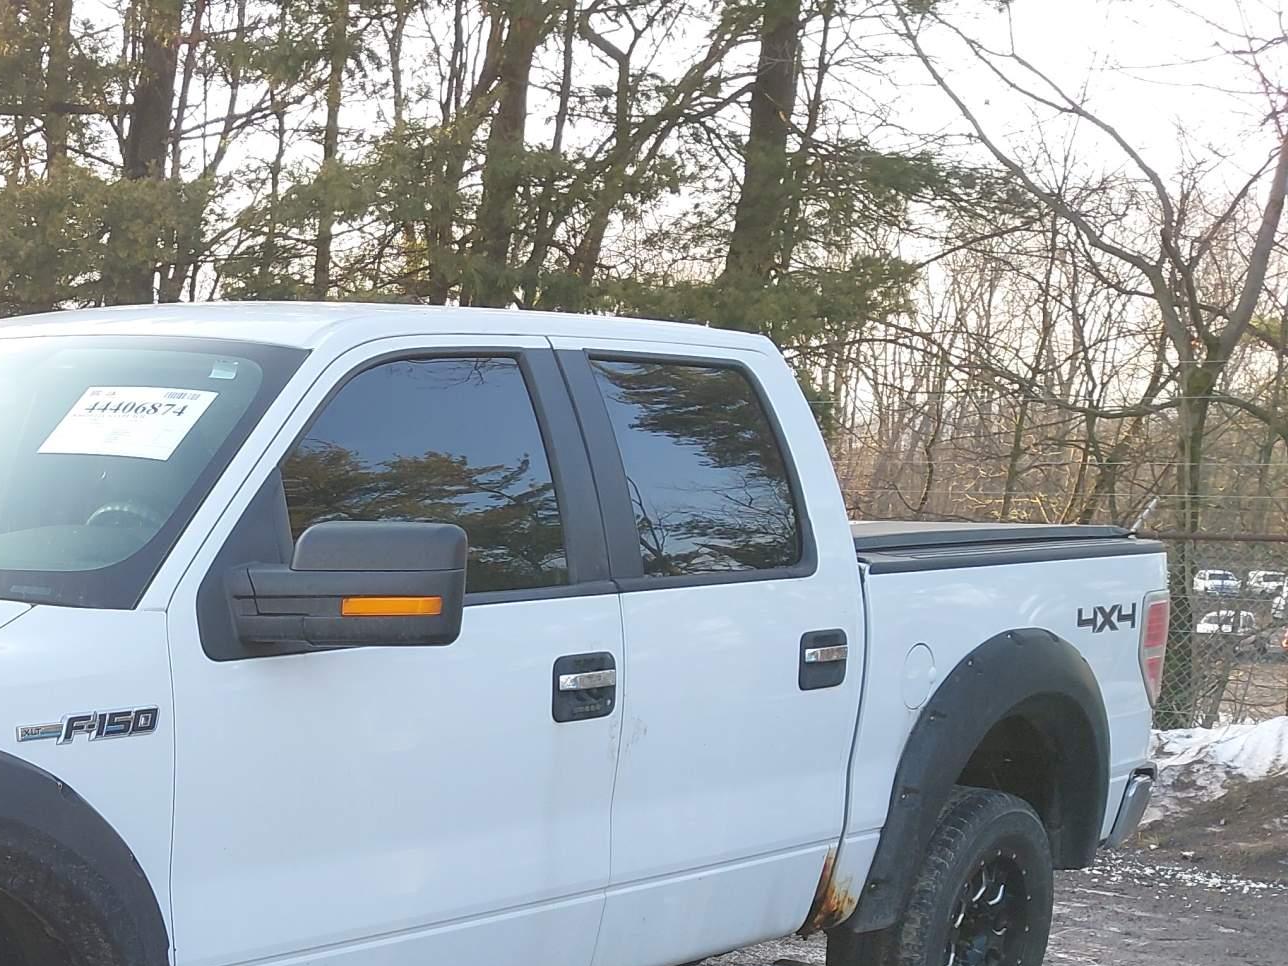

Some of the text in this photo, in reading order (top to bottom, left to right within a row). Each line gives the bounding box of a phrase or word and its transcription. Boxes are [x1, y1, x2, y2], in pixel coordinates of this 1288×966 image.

[85, 400, 189, 417] 44406874
[1077, 602, 1137, 633] 4X4
[61, 705, 159, 742] F-150
